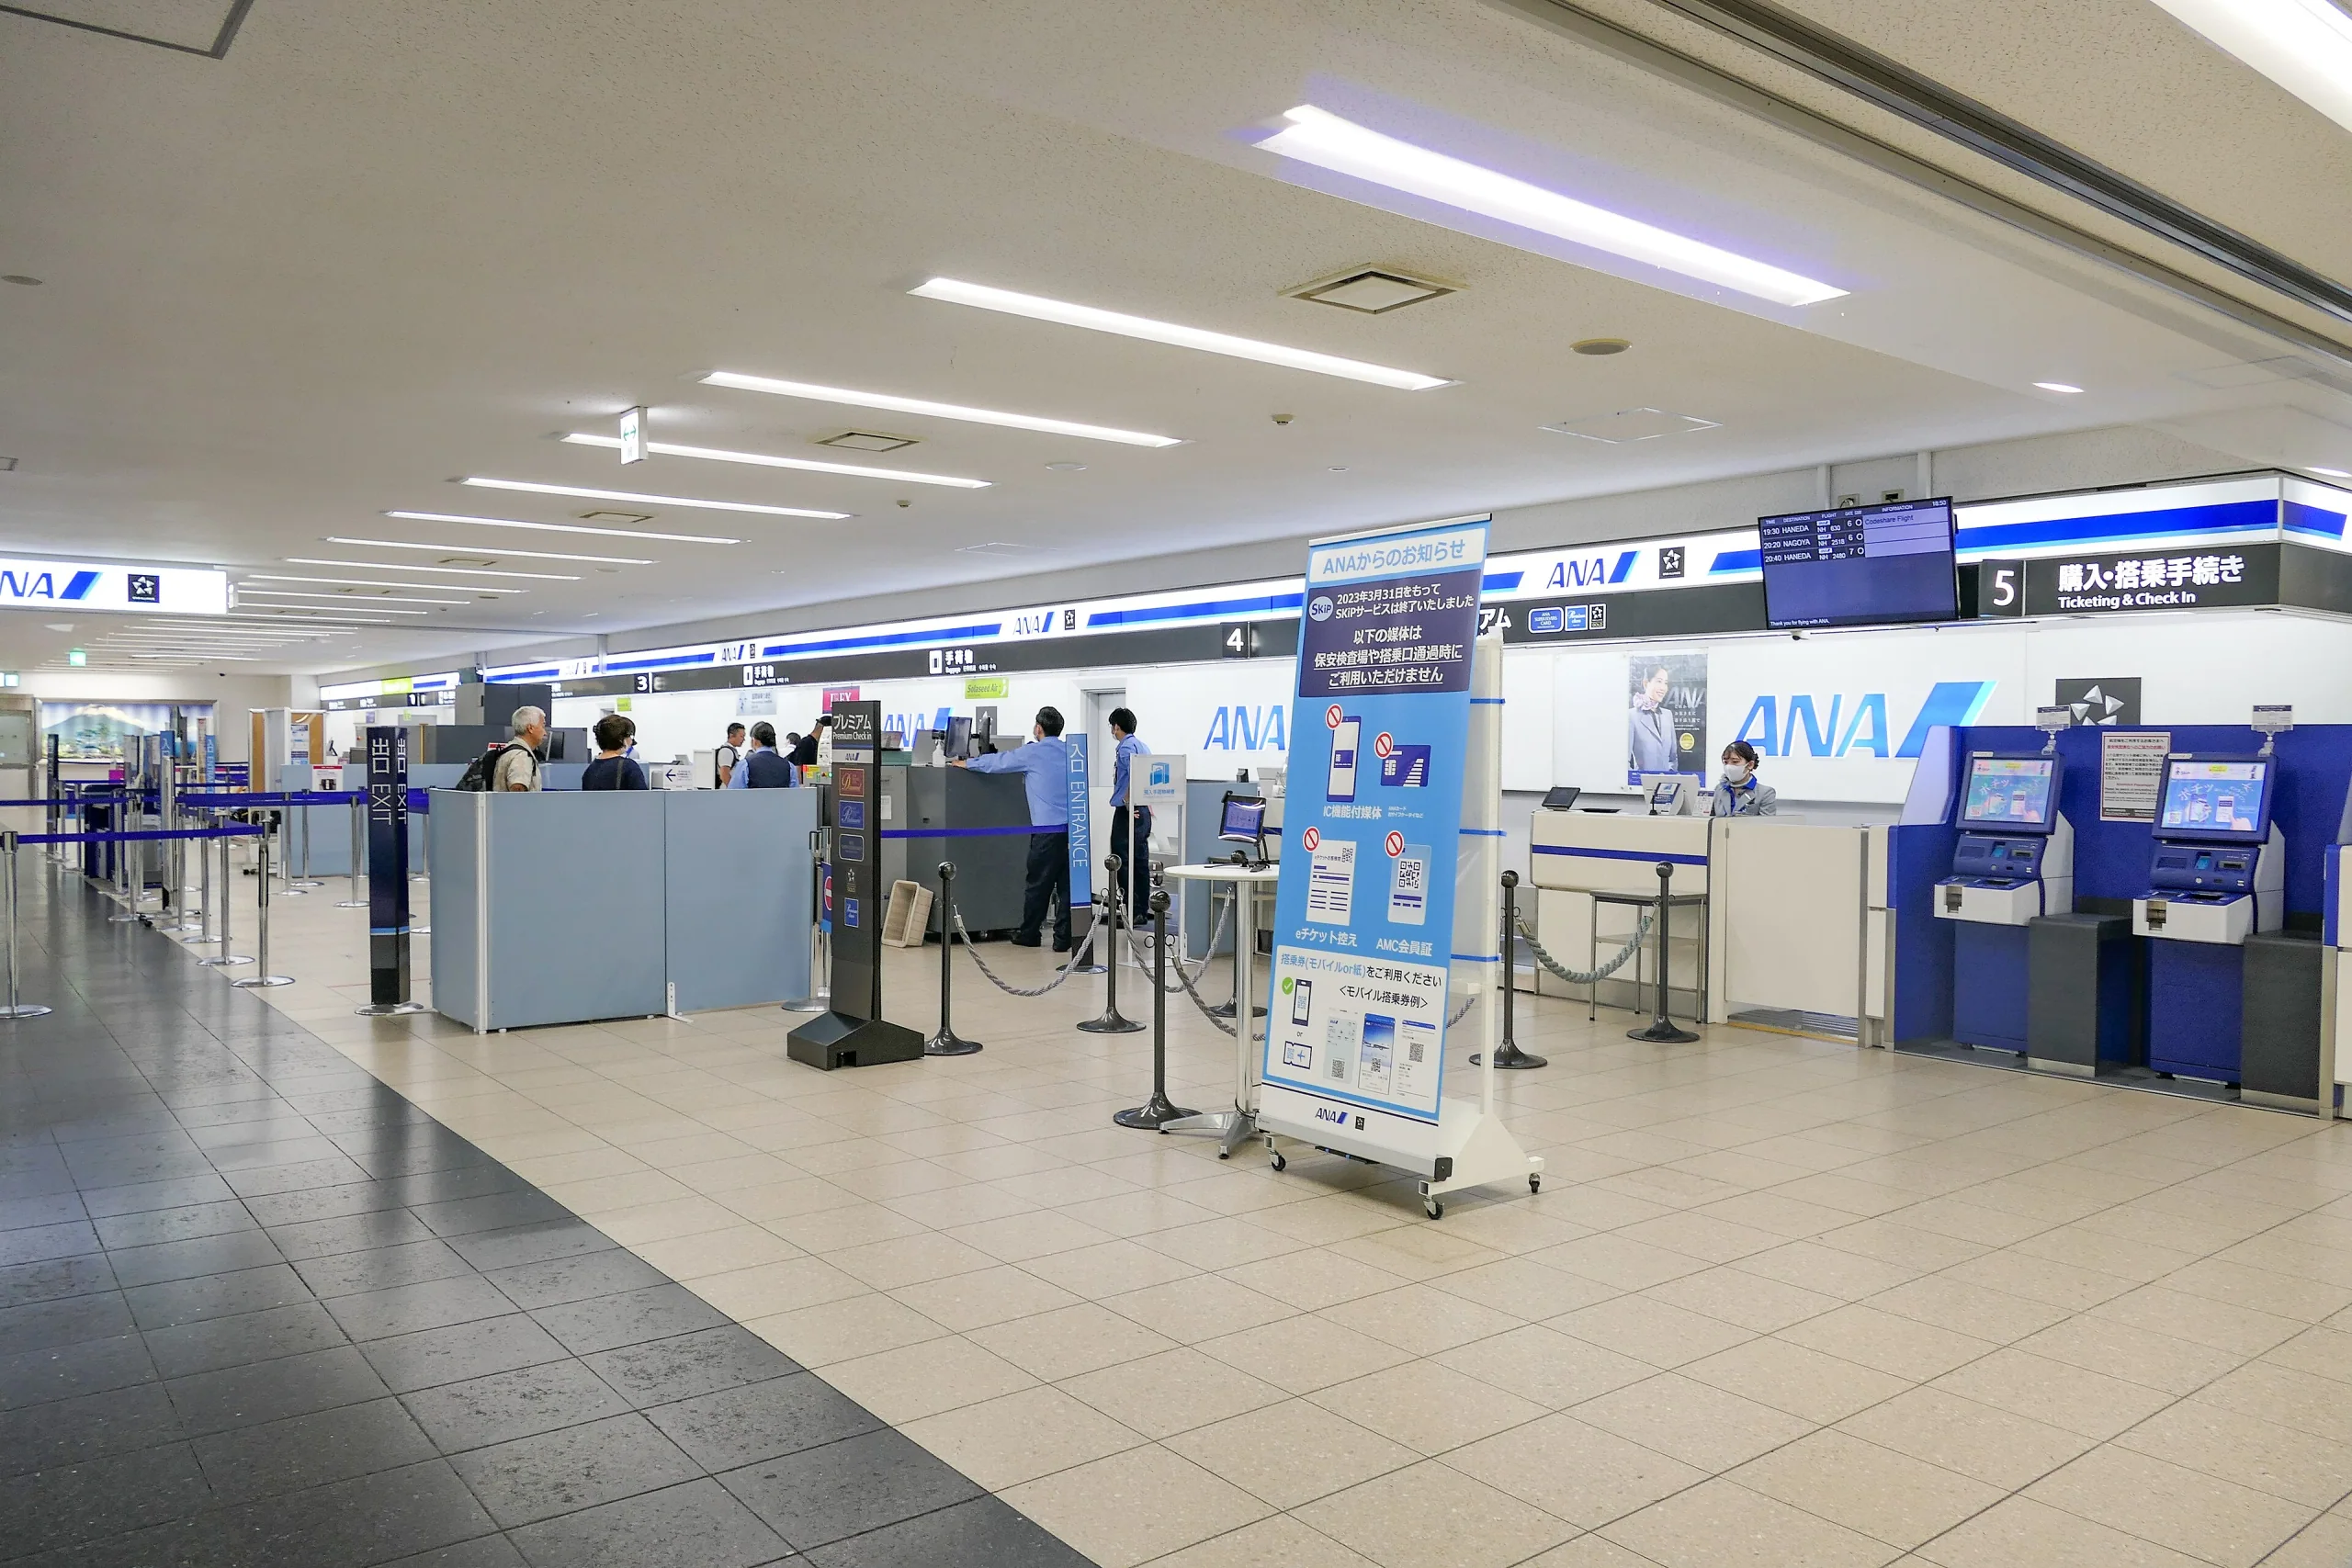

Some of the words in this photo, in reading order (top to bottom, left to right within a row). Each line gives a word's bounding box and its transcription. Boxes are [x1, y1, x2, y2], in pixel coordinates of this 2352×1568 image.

[1764, 527, 1780, 536] 19:30
[1865, 517, 1895, 525] Codeshare
[1897, 514, 1914, 523] Flight
[1782, 538, 1810, 547] NAGOYA
[1323, 539, 1465, 574] ANAからのお知らせ
[1784, 552, 1812, 560] HANEDA
[1546, 558, 1604, 589] ANA
[2058, 556, 2245, 592] 購入・搭乗手続き
[1337, 584, 1441, 604] 2023年3月31日をもって
[1993, 570, 2015, 606] 5
[1336, 595, 1474, 619] SKiPサービスは終了いたしました
[2058, 595, 2120, 610] Ticketing
[2122, 595, 2133, 606] &
[2136, 592, 2179, 605] Check
[2181, 591, 2196, 604] In
[1012, 615, 1040, 635] ANA
[1353, 626, 1422, 645] 以下の媒体は
[1226, 627, 1244, 652] 4
[1314, 644, 1463, 667] 保安検査場や搭乗口通過時に
[638, 676, 647, 691] 3
[1329, 667, 1443, 686] ご利用いただけません
[967, 684, 989, 693] Solaseed
[833, 713, 871, 730] プレミアム
[1204, 705, 1285, 750] ANA
[1736, 694, 1889, 758] ANA
[832, 731, 853, 740] Premium
[853, 732, 866, 740] Check
[372, 738, 390, 773] 出口
[397, 738, 406, 773] 出口
[1070, 744, 1084, 773] 入口
[372, 784, 391, 825] EXIT
[397, 784, 407, 825] EXIT
[1323, 805, 1382, 819] IC機能付媒体
[1071, 781, 1088, 867] ENTRANCE
[1295, 928, 1358, 947] eチケット控え
[1376, 938, 1433, 957] AMC会員証
[1315, 1108, 1336, 1122] ANA
